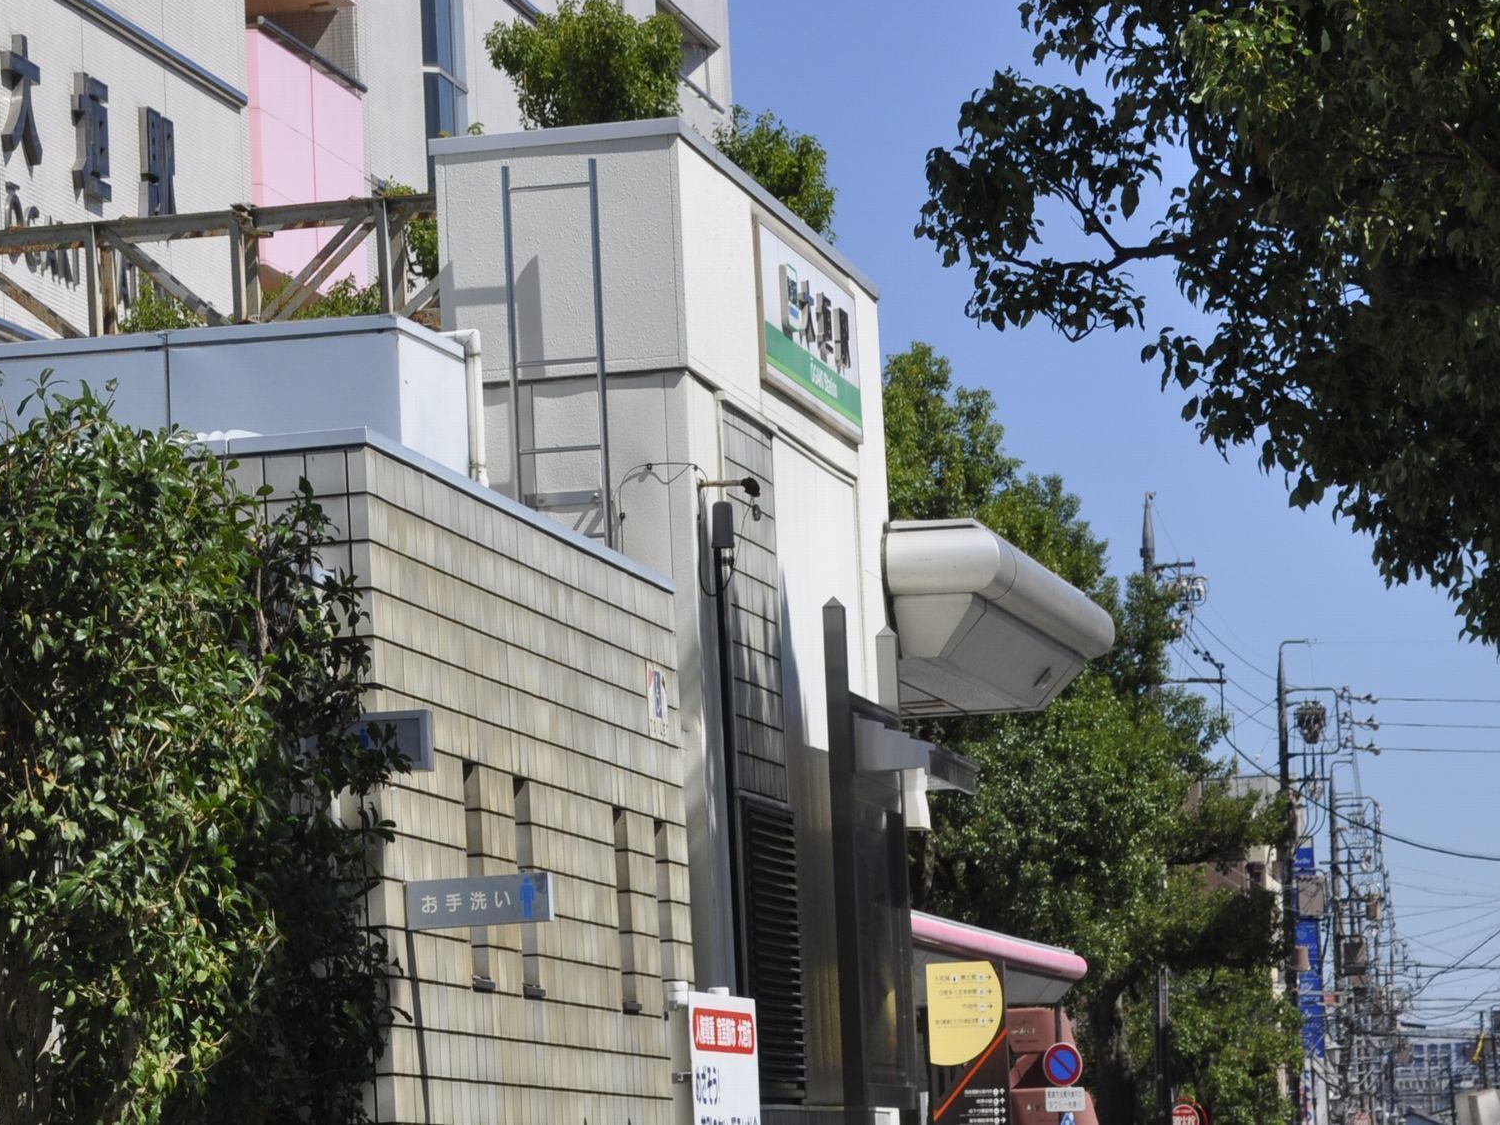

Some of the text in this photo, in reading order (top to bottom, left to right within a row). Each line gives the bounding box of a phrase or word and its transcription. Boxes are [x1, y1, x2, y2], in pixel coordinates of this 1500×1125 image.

[0, 33, 178, 216] 大垣駅
[798, 279, 851, 369] 大垣駅
[420, 890, 511, 914] お手洗い
